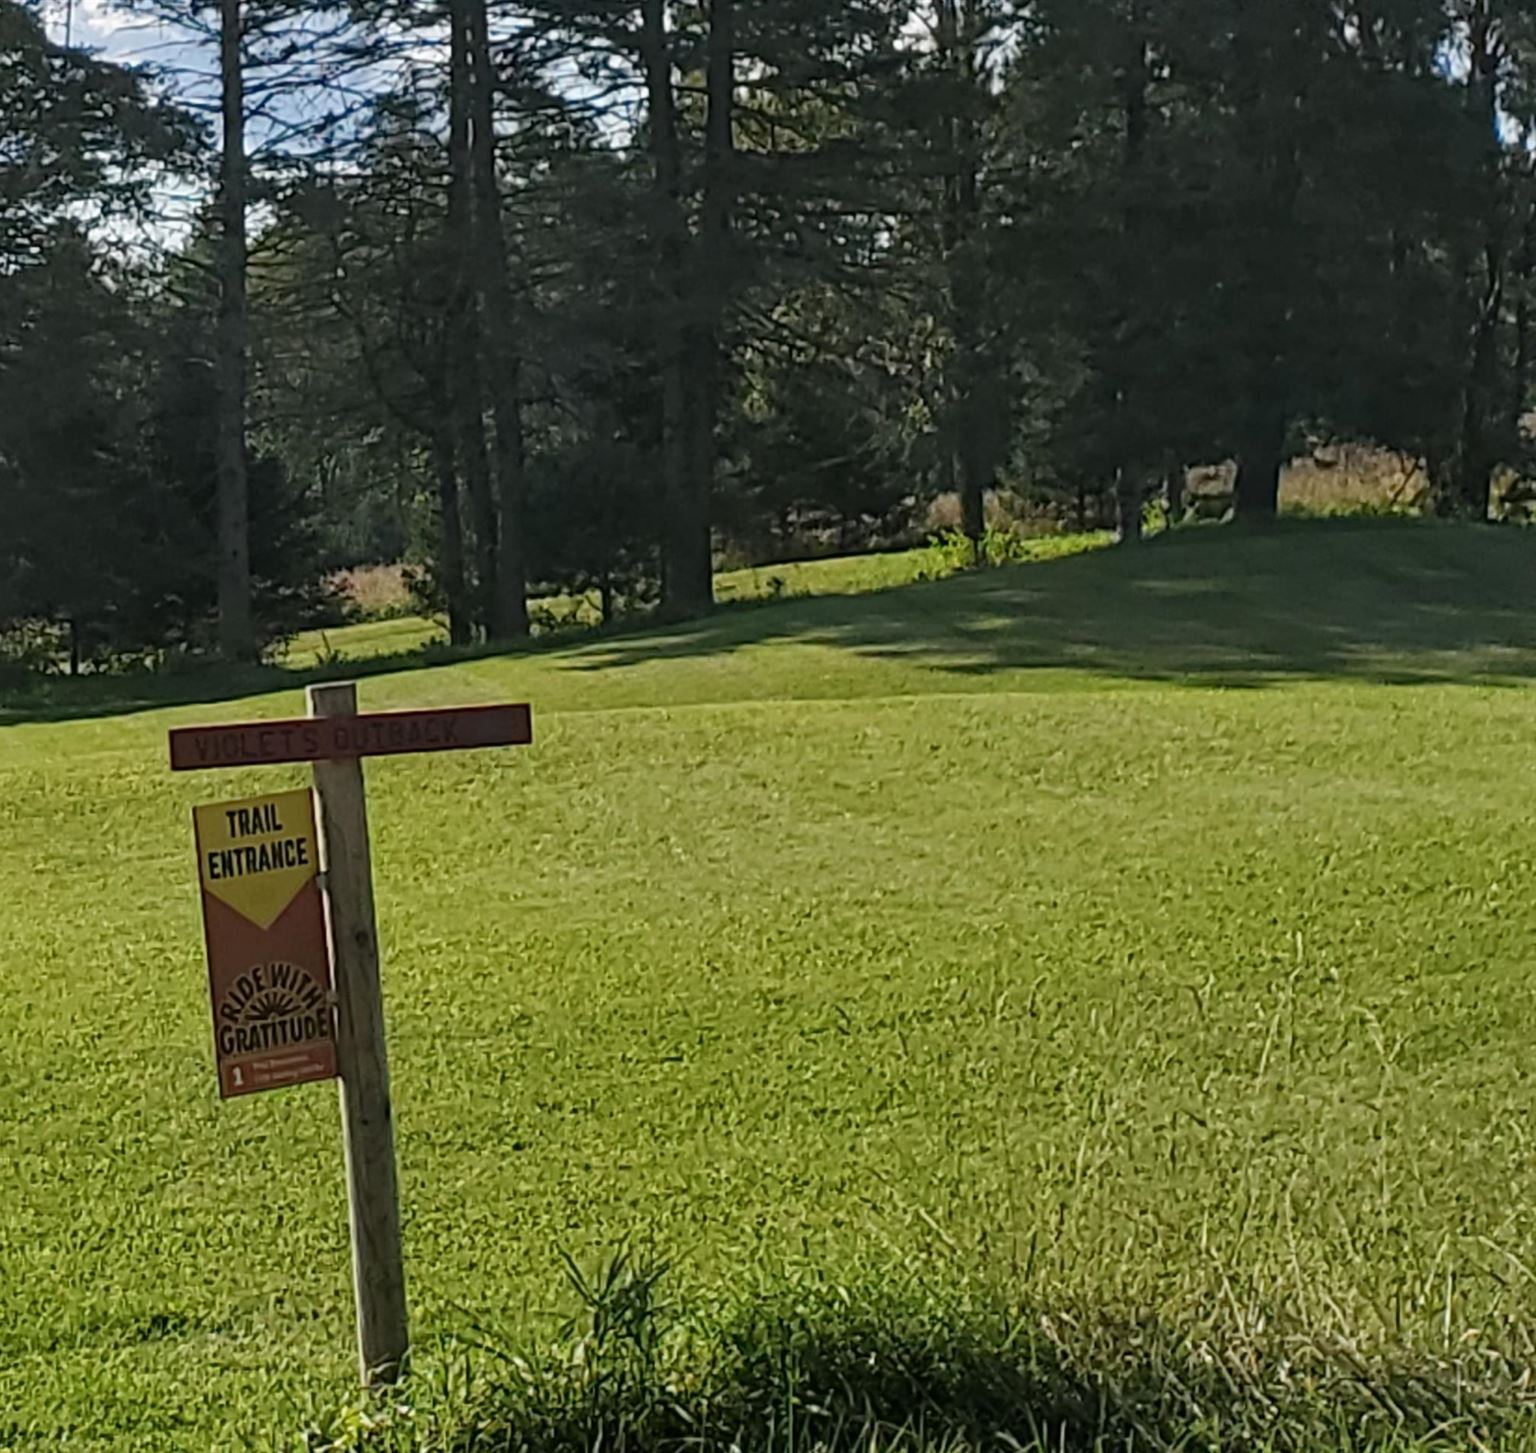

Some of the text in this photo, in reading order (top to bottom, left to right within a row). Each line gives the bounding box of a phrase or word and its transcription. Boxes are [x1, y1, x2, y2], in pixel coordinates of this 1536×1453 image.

[334, 717, 458, 751] OUTBACK
[226, 803, 282, 838] TRAIL
[208, 838, 308, 880] ENTRANCE
[220, 964, 323, 1023] RIDE WITH
[220, 1007, 328, 1054] GRATITUDE
[232, 1066, 244, 1087] 1
